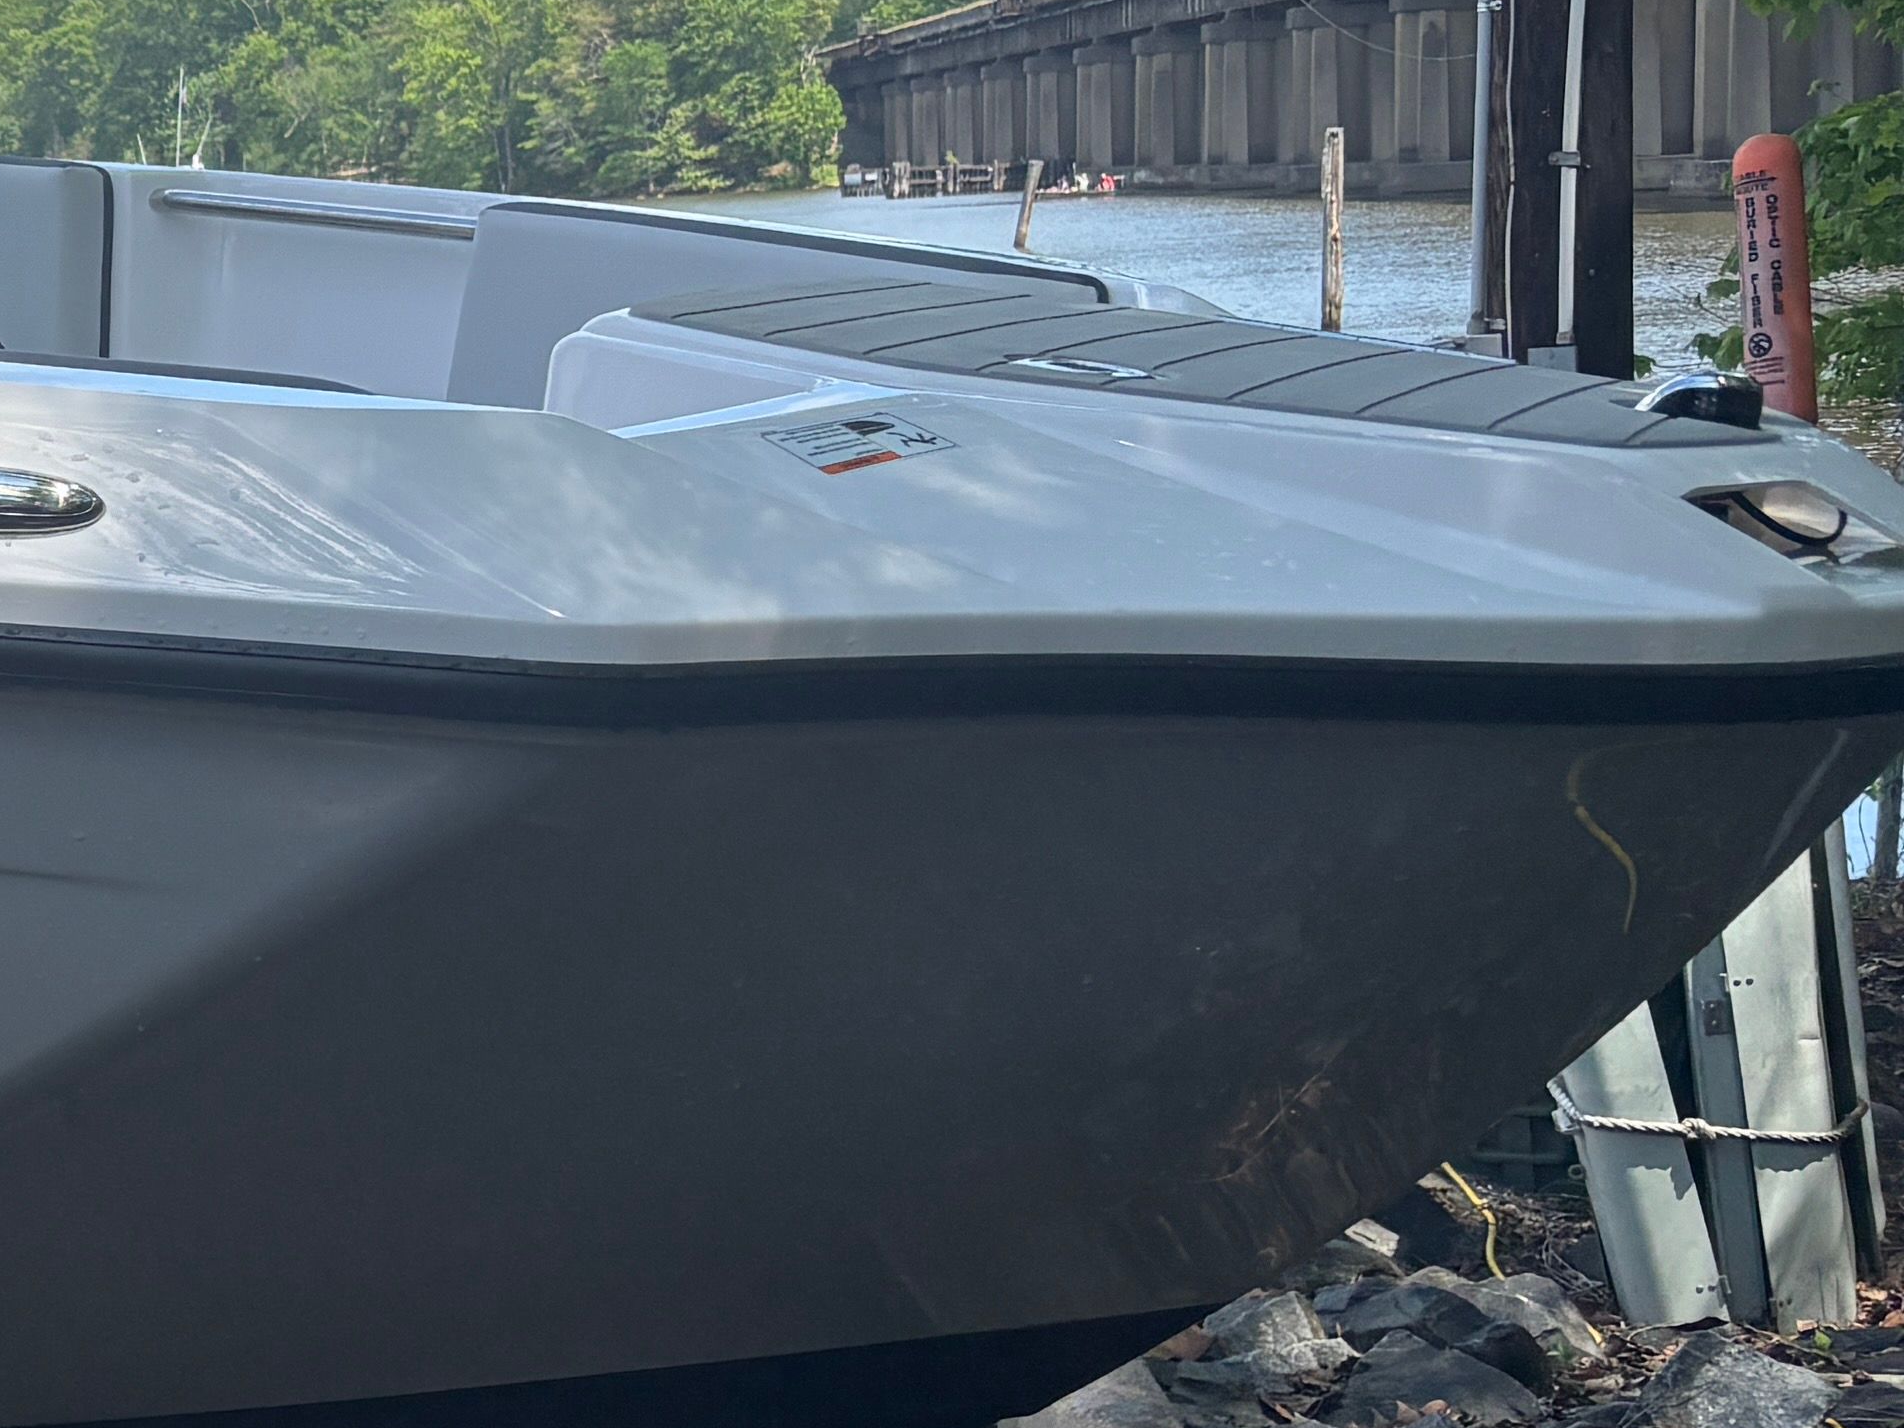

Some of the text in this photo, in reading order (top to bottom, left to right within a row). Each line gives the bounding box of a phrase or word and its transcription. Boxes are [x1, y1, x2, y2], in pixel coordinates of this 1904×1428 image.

[1745, 197, 1763, 328] BURIED FIBER
[1766, 194, 1784, 315] OPTIC CABLE
